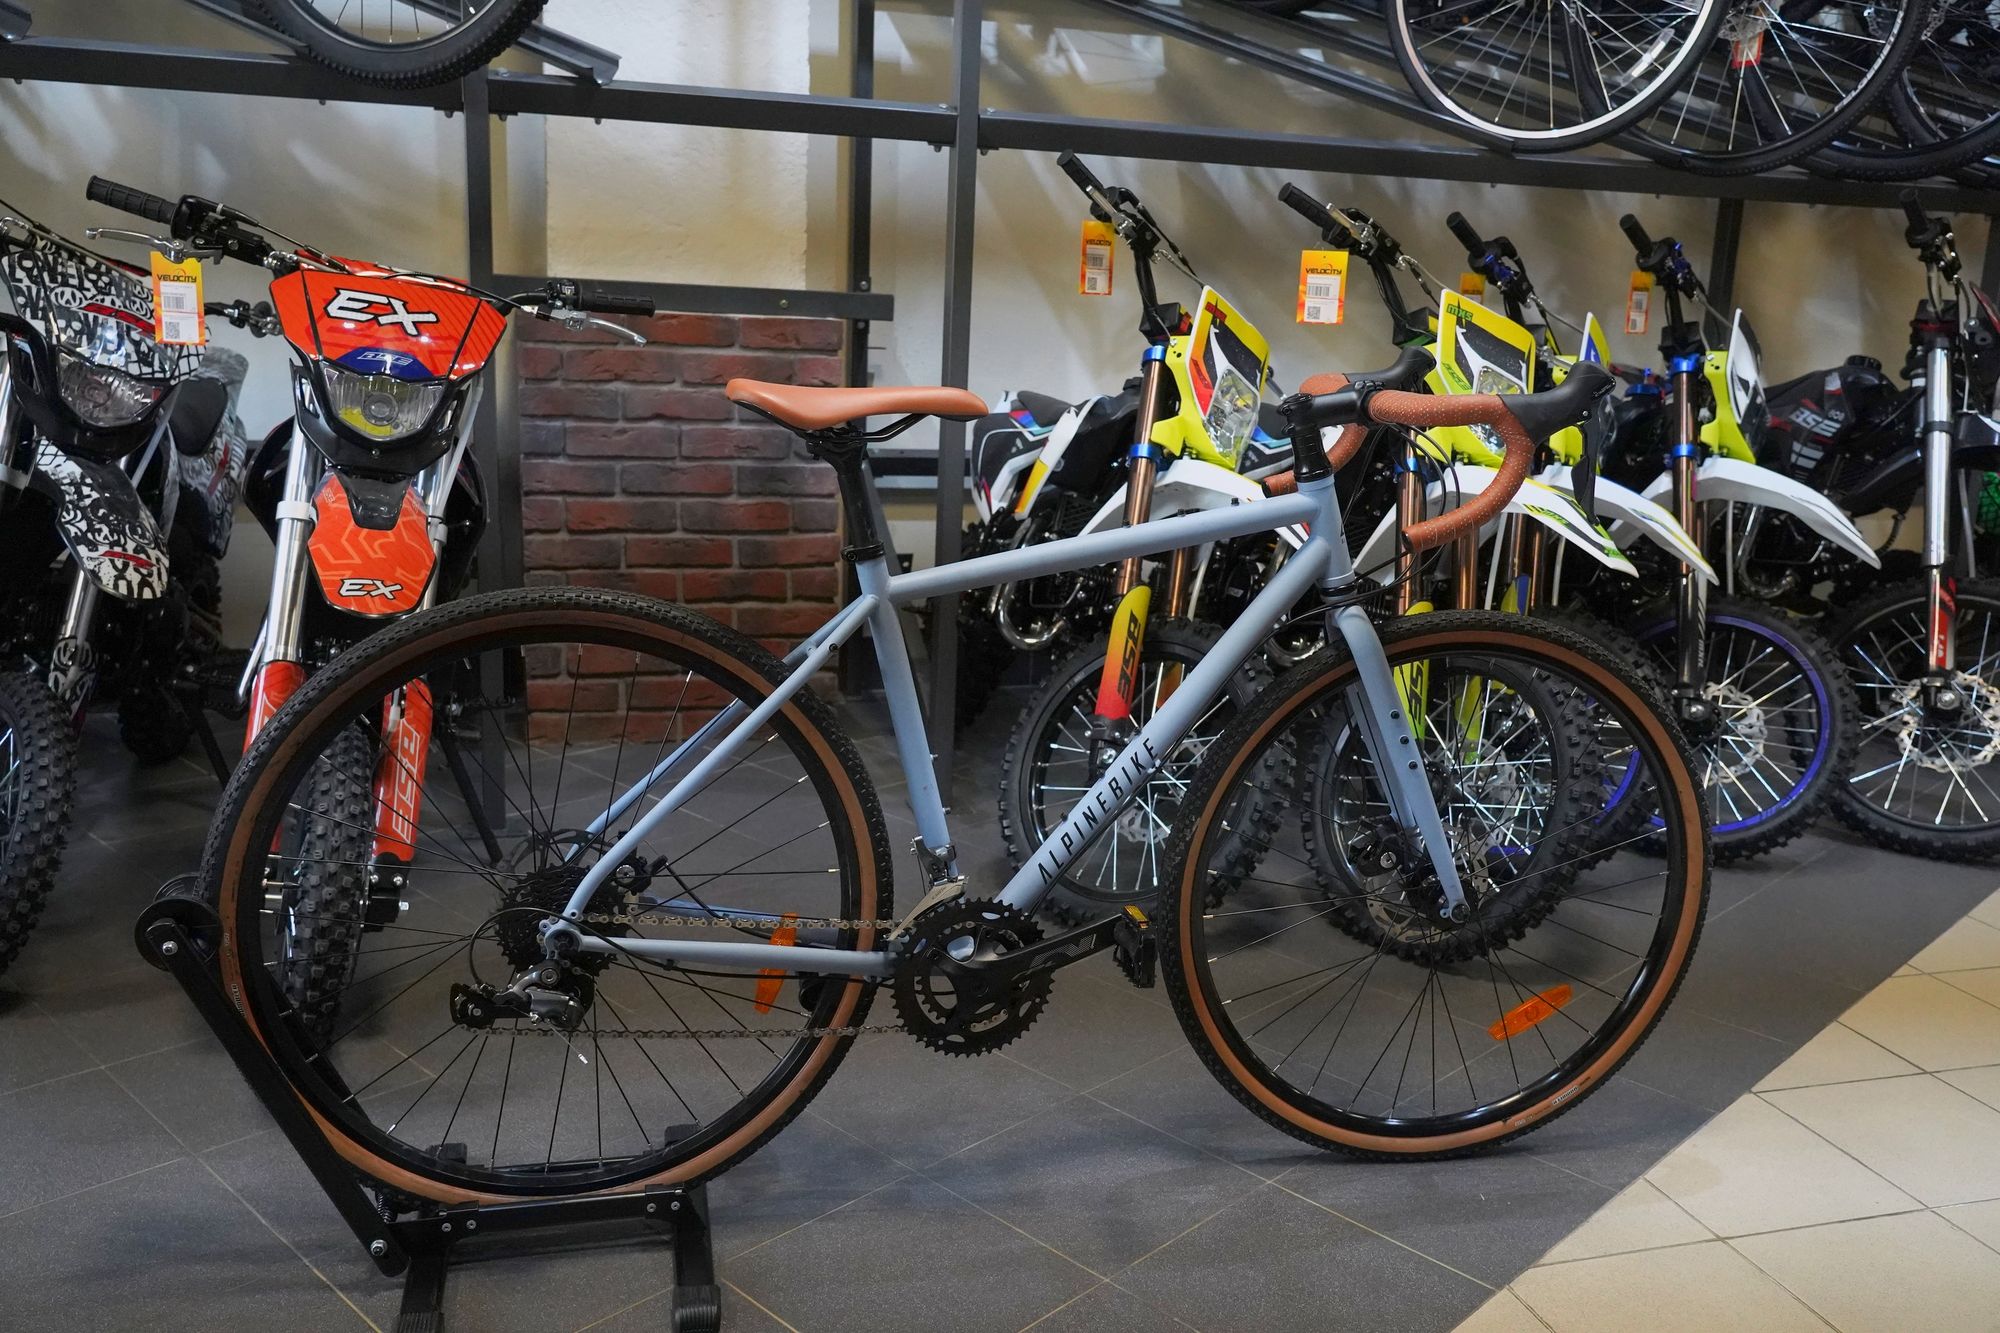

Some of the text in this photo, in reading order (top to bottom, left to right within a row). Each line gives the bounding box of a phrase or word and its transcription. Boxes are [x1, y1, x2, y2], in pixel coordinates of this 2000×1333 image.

[157, 273, 197, 283] VELOCITY
[1305, 267, 1342, 275] VELOCITY
[324, 287, 439, 336] EX
[338, 577, 403, 601] EX
[1037, 737, 1158, 886] ALPINEBIKE
